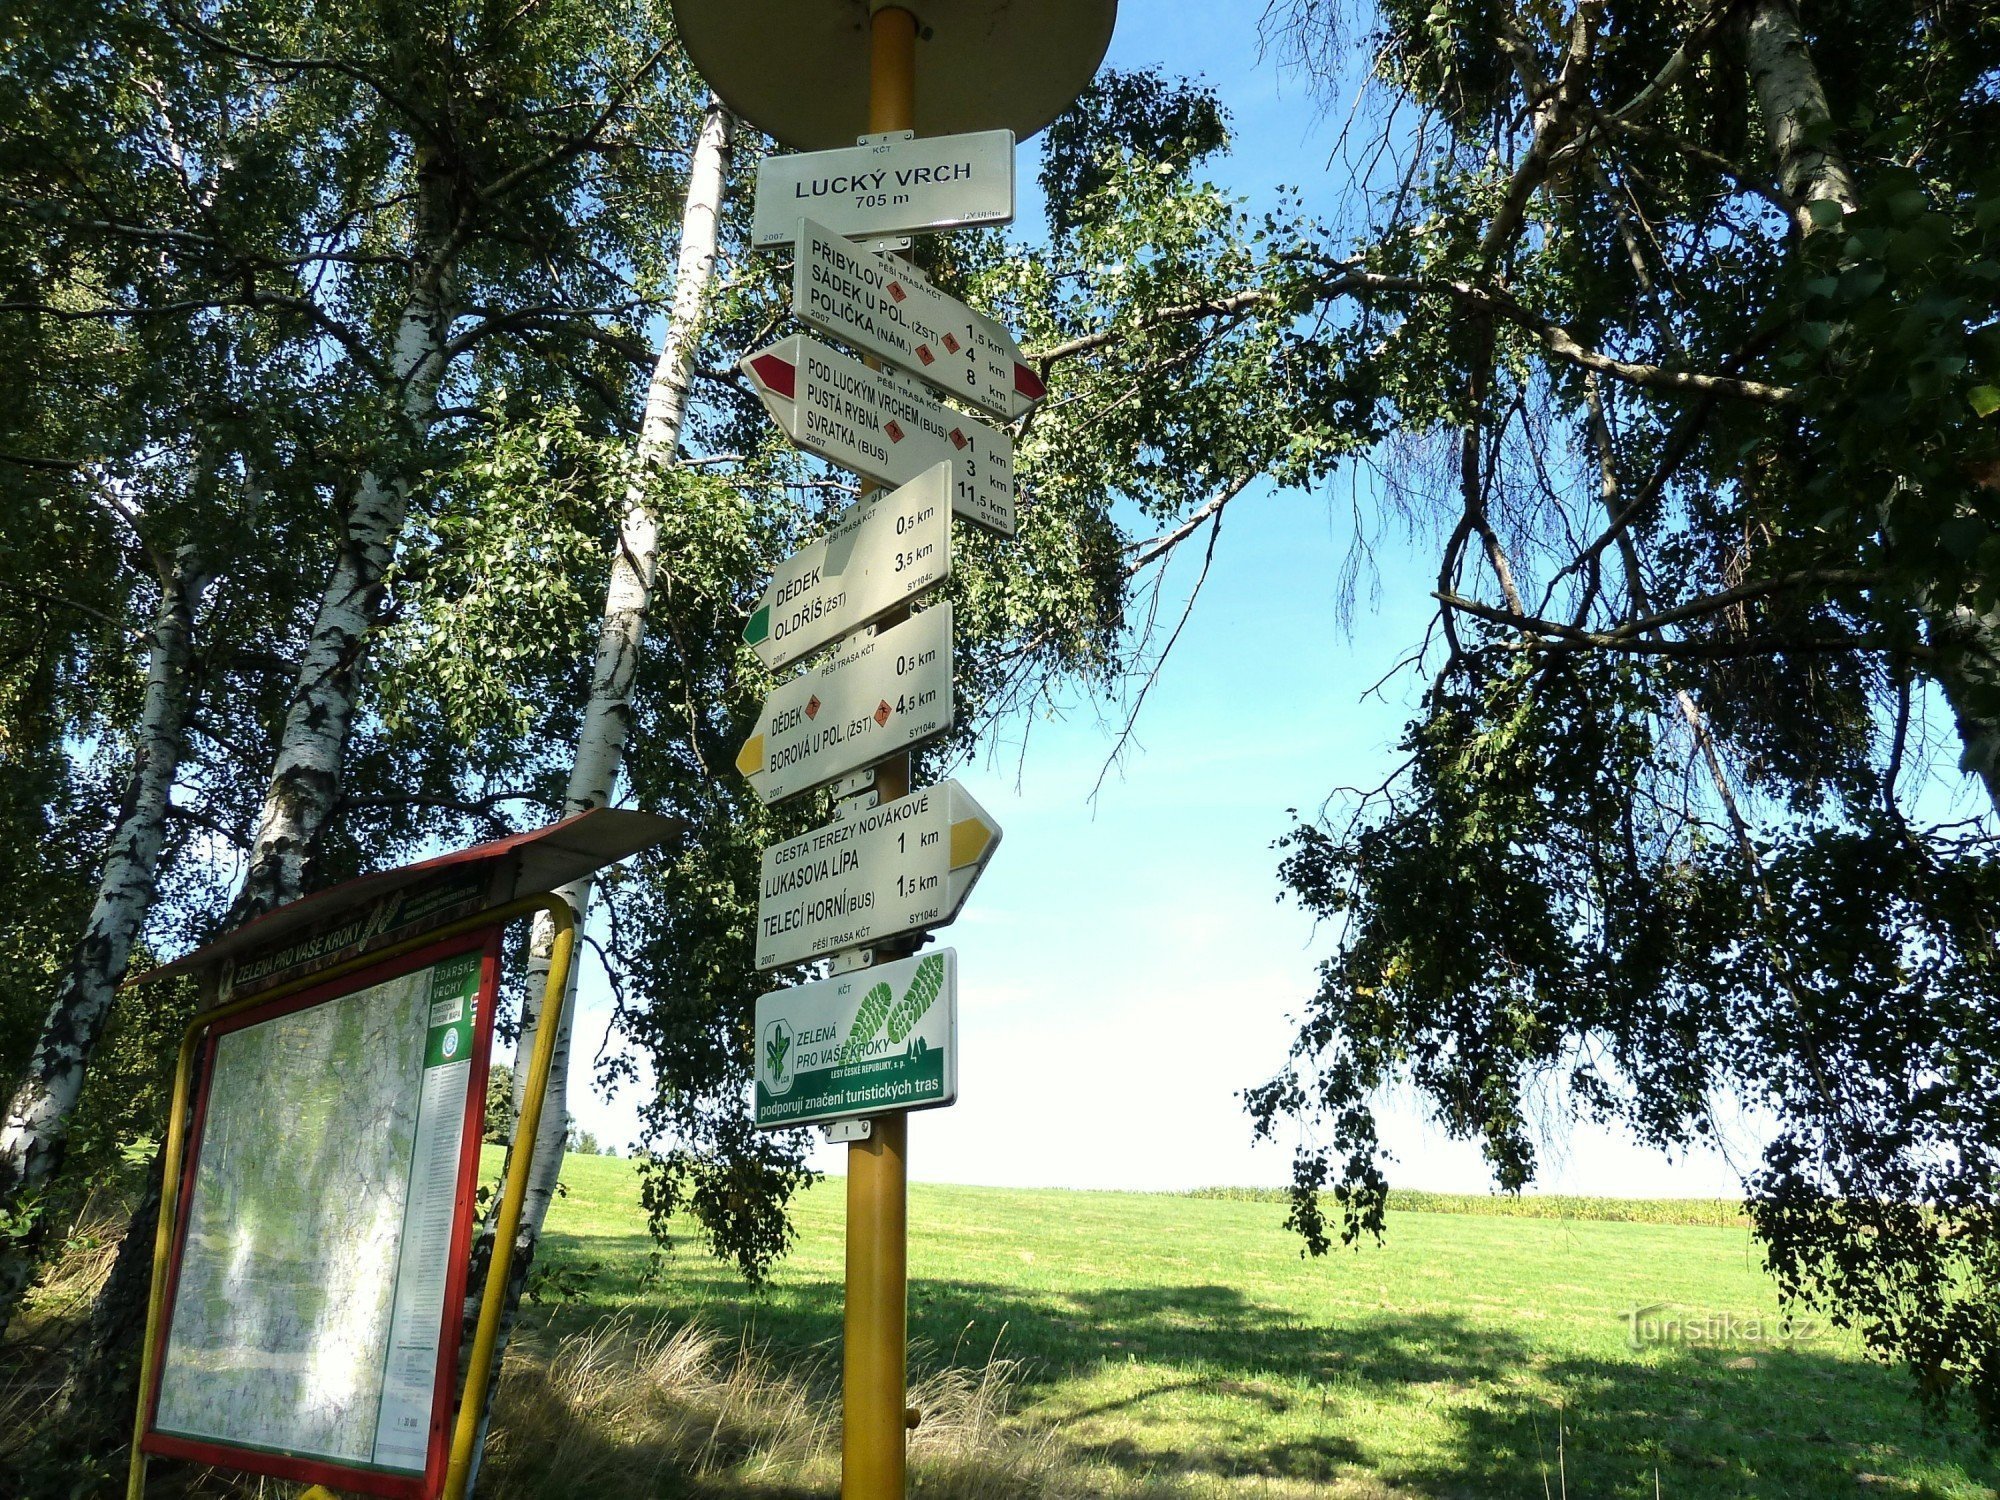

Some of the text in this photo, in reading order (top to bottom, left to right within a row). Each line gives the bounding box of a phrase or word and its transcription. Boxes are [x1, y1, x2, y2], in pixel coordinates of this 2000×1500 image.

[795, 162, 971, 199] LUCKÝ VRCH
[855, 193, 909, 209] 705 m
[763, 233, 784, 242] 2007
[811, 239, 884, 290] PŘIBYLOV
[898, 271, 924, 293] TRASA
[926, 286, 942, 301] KČT
[810, 309, 830, 324] 2007
[811, 264, 939, 346] SÁDEK U POL. (ŽST)
[811, 288, 912, 356] POLIČKA (NÁM.)
[965, 324, 1005, 357] 1,5 km
[965, 347, 1006, 379] 4 km
[808, 358, 948, 443] POD LUCKÝM VRCHEM (BUS)
[898, 386, 925, 406] TRASA
[926, 400, 943, 414] KČT
[966, 369, 1006, 402] 8 km
[807, 384, 880, 433] PUSTÁ RYBNÁ
[806, 433, 827, 448] 2007
[807, 411, 889, 465] SVRATKA (BUS)
[967, 437, 1007, 469] 1 km
[966, 459, 1007, 493] 3 km
[958, 481, 1008, 517] 11,5 km
[839, 519, 862, 538] TRASA
[862, 508, 876, 525] KČT
[896, 506, 934, 535] 0,5 km
[895, 543, 933, 573] 3,5 km
[776, 565, 821, 608] DĚDEK
[907, 573, 933, 592] SY104c
[775, 591, 847, 641] OLDŘÍŠ (ŽST)
[772, 652, 786, 666] 2007
[837, 651, 860, 671] TRASA
[860, 643, 876, 659] KČT
[896, 649, 936, 676] 0,5 km
[895, 689, 936, 716] 4,5 km
[771, 705, 803, 738] DĚDEK
[909, 721, 936, 739] SY104e
[770, 715, 872, 774] BOROVÁ U POL. (ŽST)
[769, 785, 783, 799] 2007
[775, 794, 929, 865] CESTA TEREZY NOVÁKOVÉ
[897, 830, 939, 854] 1 km
[765, 849, 859, 900] LUKASOVA LÍPA
[896, 874, 938, 899] 1,5 km
[763, 888, 875, 938] TELECÍ HORNÍ (BUS)
[909, 907, 938, 924] SY104d
[274, 949, 294, 971] PRO
[323, 920, 363, 954] KROKY
[830, 931, 854, 947] TRASA
[855, 926, 871, 941] KČT
[761, 954, 776, 966] 2007
[433, 979, 463, 999] VRCHY
[837, 984, 851, 996] KČT
[796, 1022, 837, 1047] ZELENÁ
[796, 1038, 891, 1069] PRO VAŠE KROKY
[830, 1069, 844, 1079] LESY
[760, 1078, 939, 1120] podporují značení turistických tras
